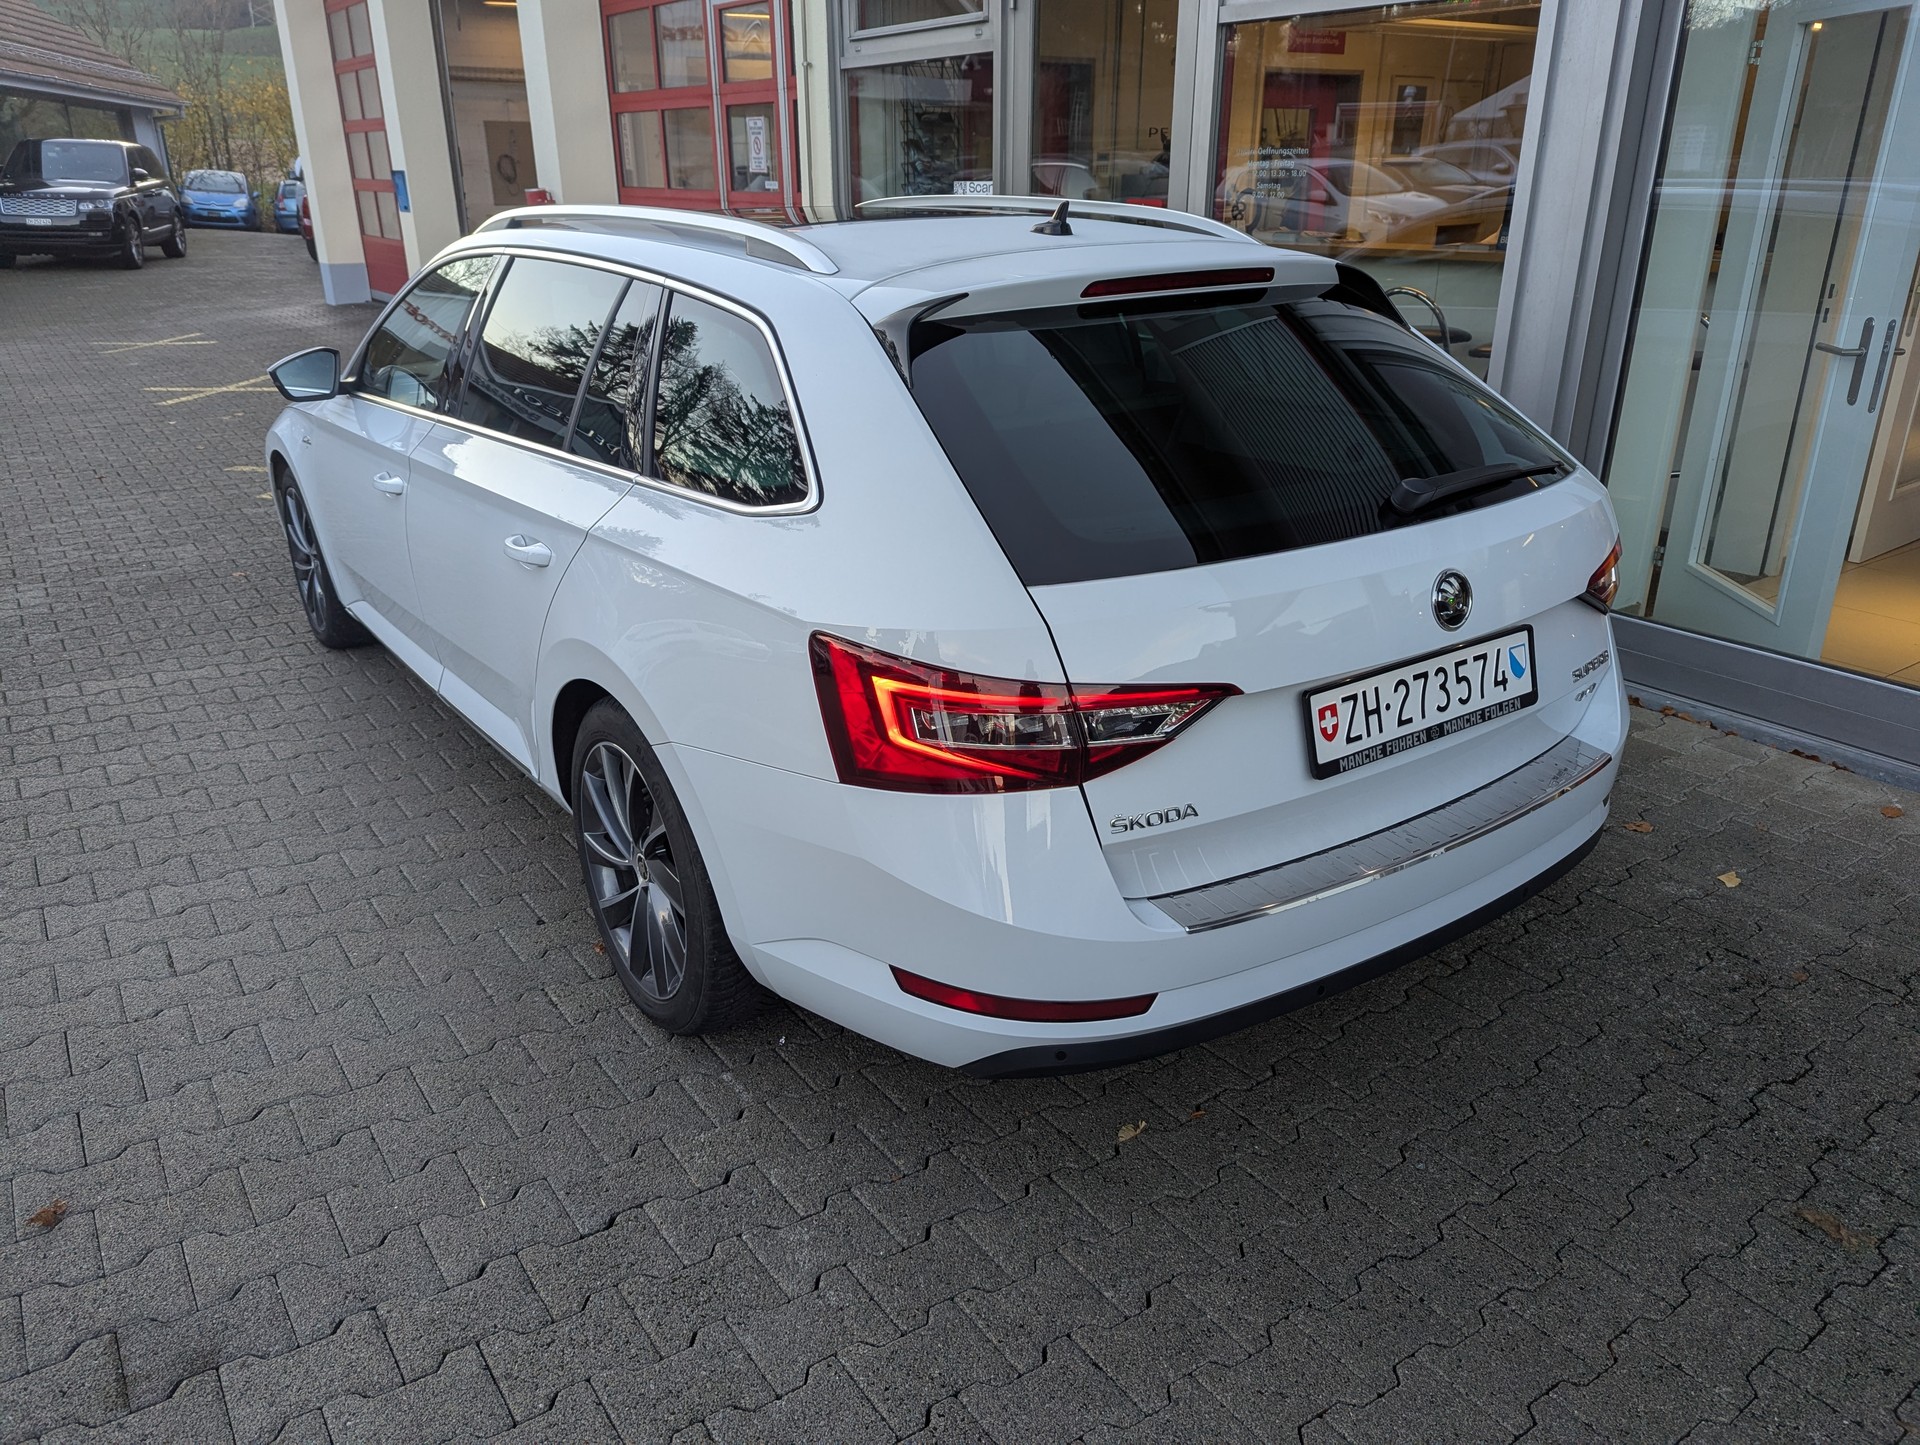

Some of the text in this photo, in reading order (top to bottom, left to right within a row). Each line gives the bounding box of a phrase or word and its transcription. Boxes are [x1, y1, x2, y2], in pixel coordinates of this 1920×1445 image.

[1257, 147, 1309, 156] Oeffnungszeiten
[1248, 160, 1270, 168] Montag
[1274, 160, 1295, 168] Freitag
[1291, 169, 1307, 177] 18.00
[1256, 182, 1281, 191] Samstag
[1339, 744, 1384, 772] MANCHE
[1443, 710, 1483, 736] MANCHE
[1484, 696, 1521, 721] FOLGEN
[1109, 802, 1200, 835] ŠKODA
